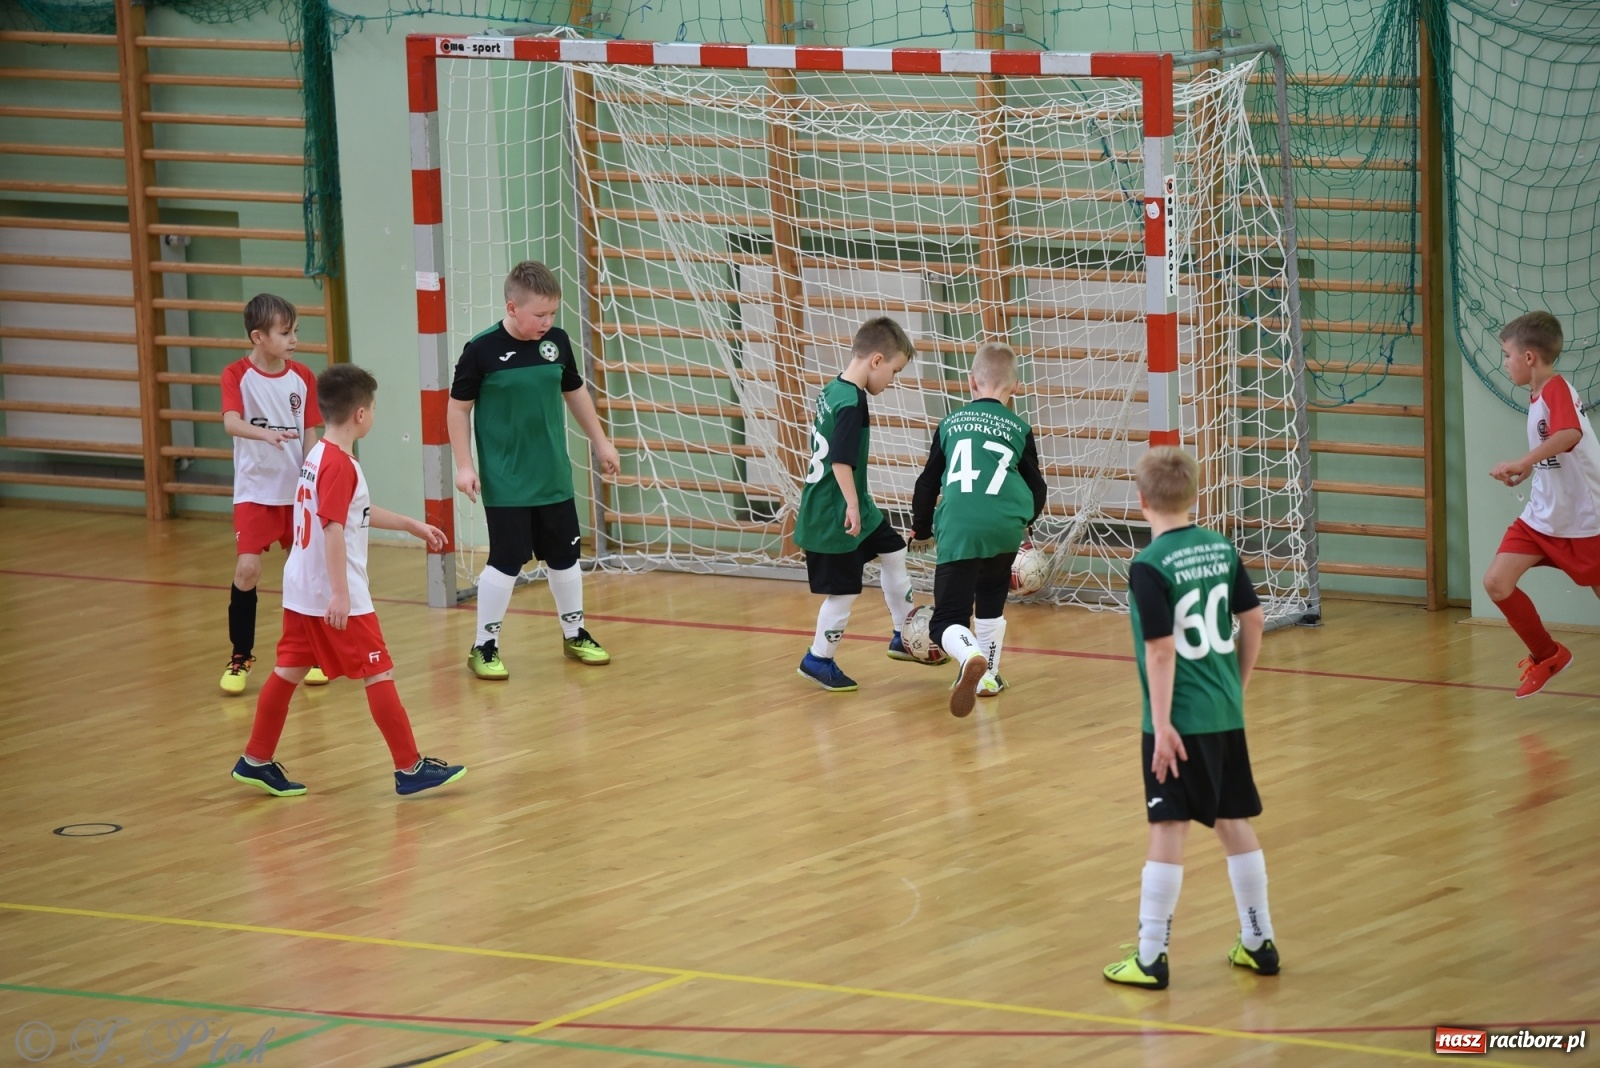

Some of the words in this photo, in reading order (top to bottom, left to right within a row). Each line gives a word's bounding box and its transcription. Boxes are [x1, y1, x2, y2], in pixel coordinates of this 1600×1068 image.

[472, 42, 501, 54] sport
[946, 438, 1014, 495] 47
[1173, 582, 1235, 660] 60
